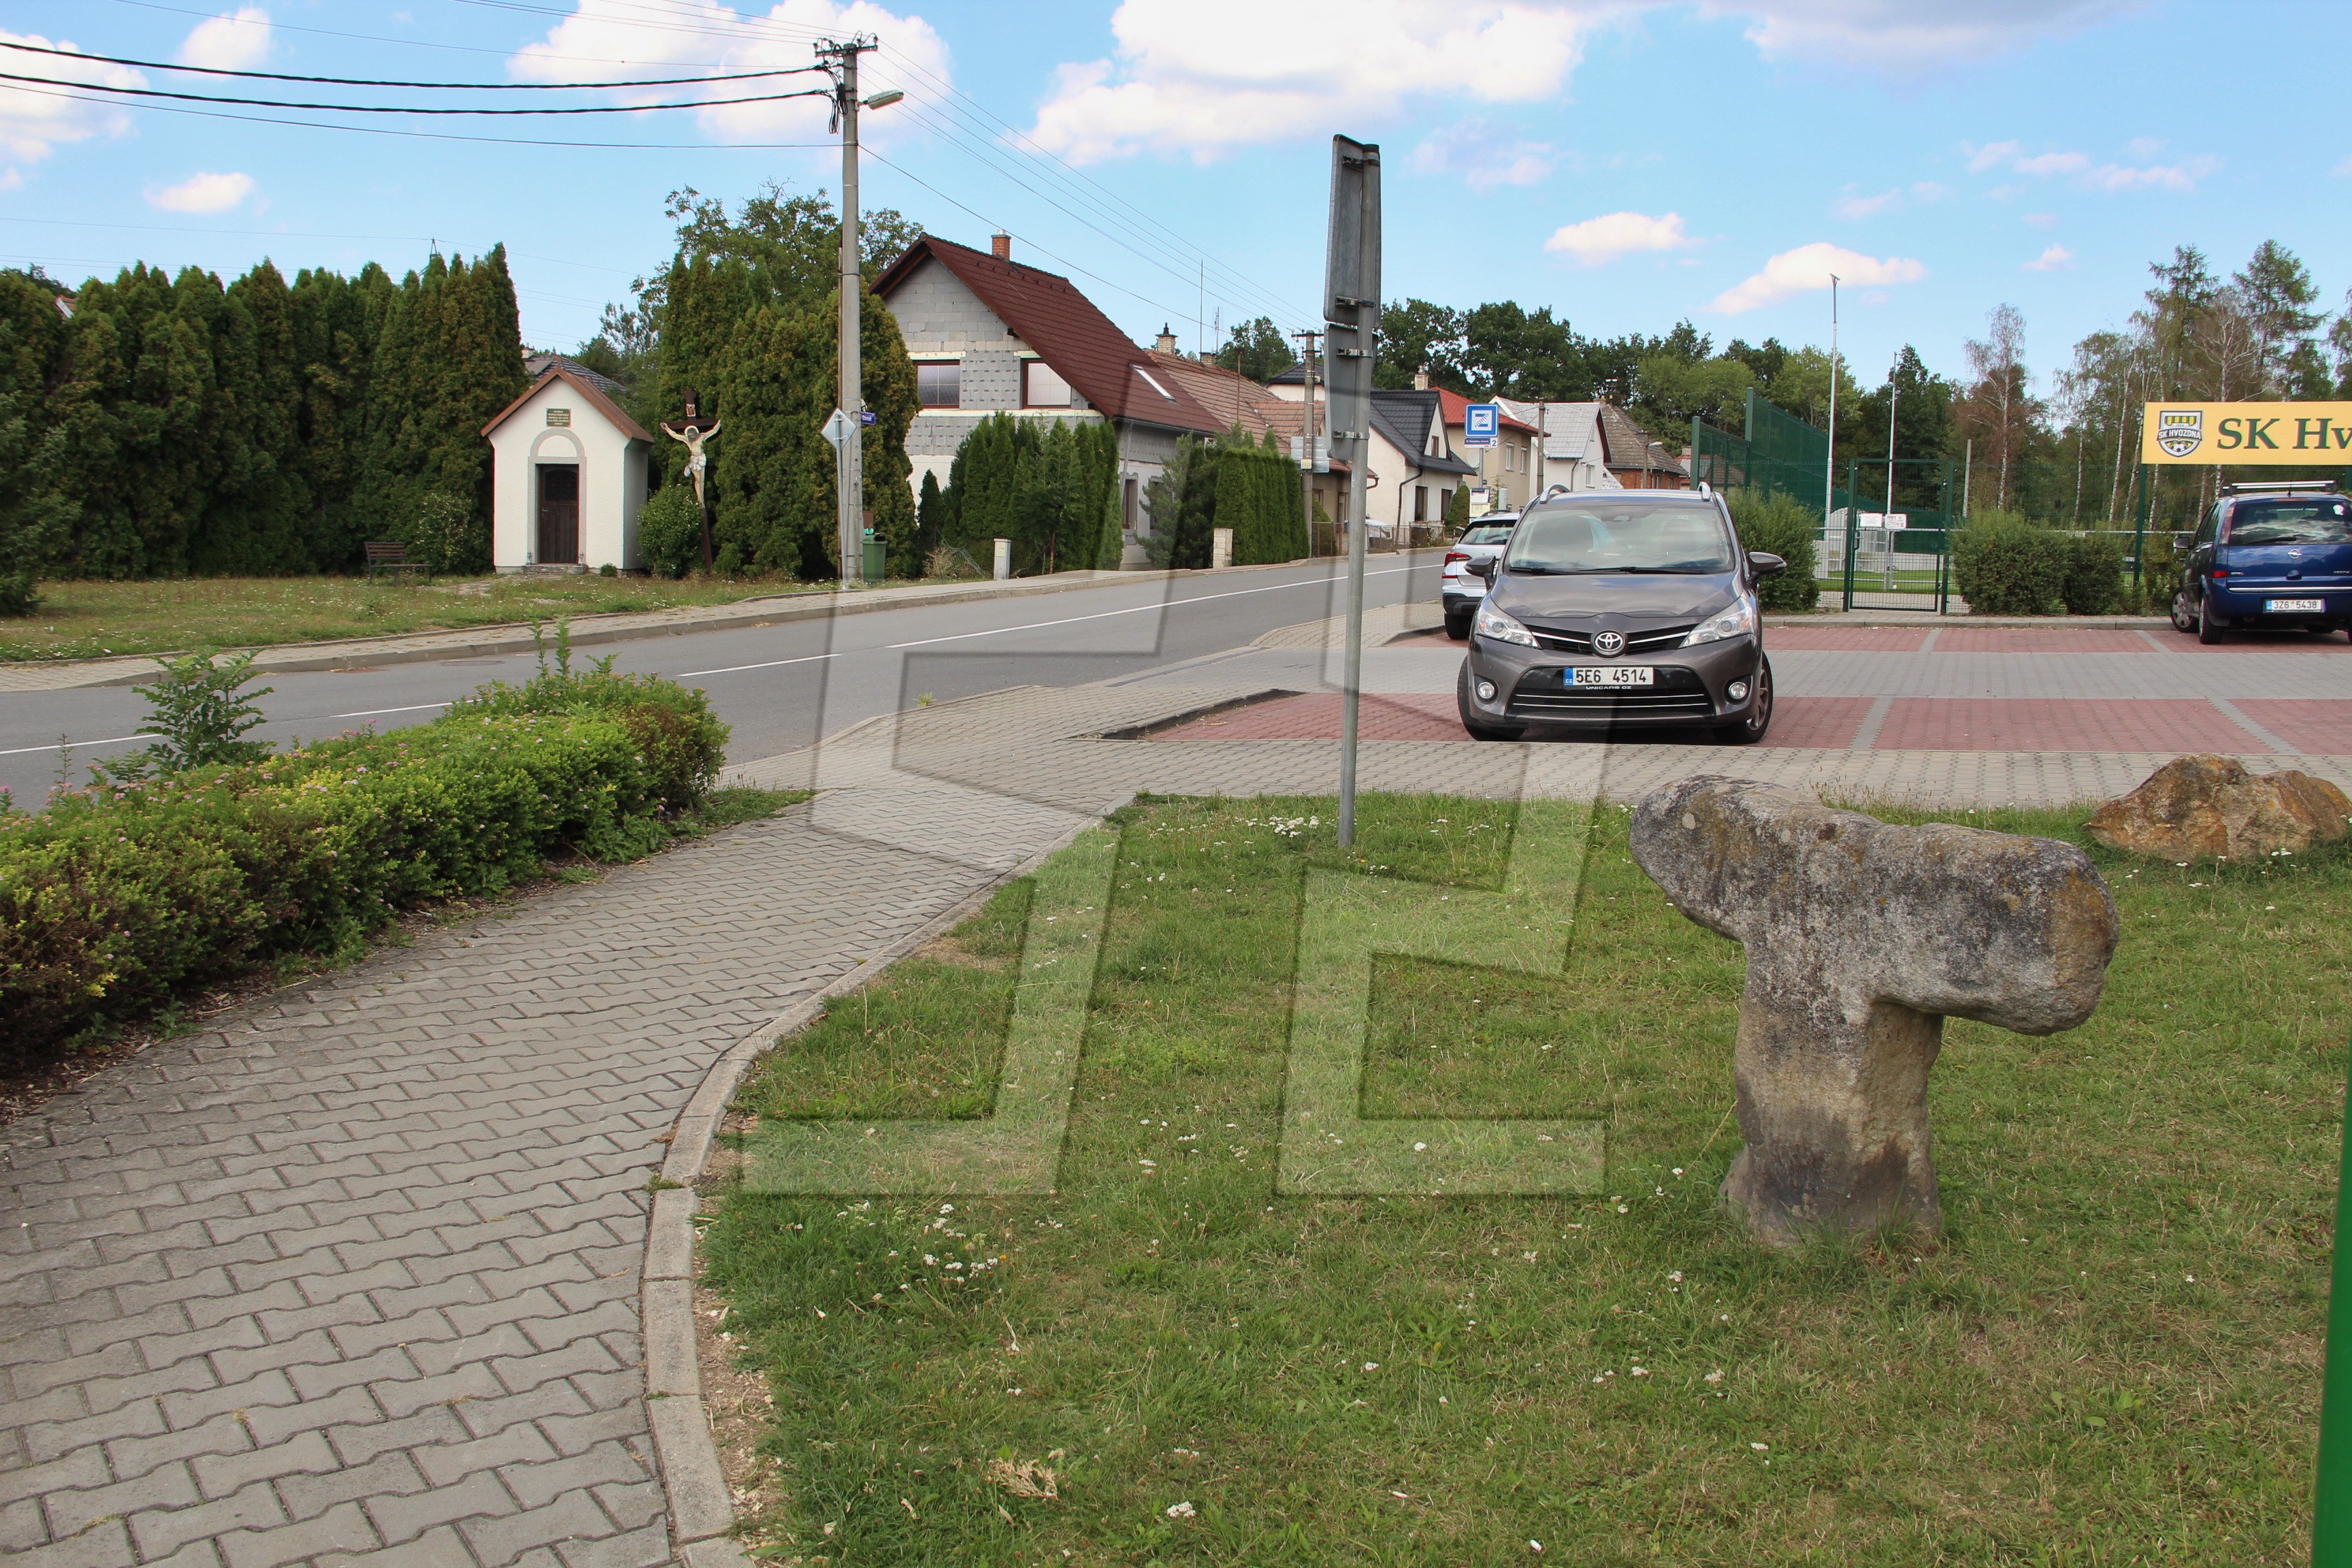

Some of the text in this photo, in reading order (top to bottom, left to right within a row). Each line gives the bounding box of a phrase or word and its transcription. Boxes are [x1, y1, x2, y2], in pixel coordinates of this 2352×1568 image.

[2158, 431, 2168, 439] SK
[2217, 418, 2280, 450] SK
[1575, 669, 1646, 683] 5E6 4514
